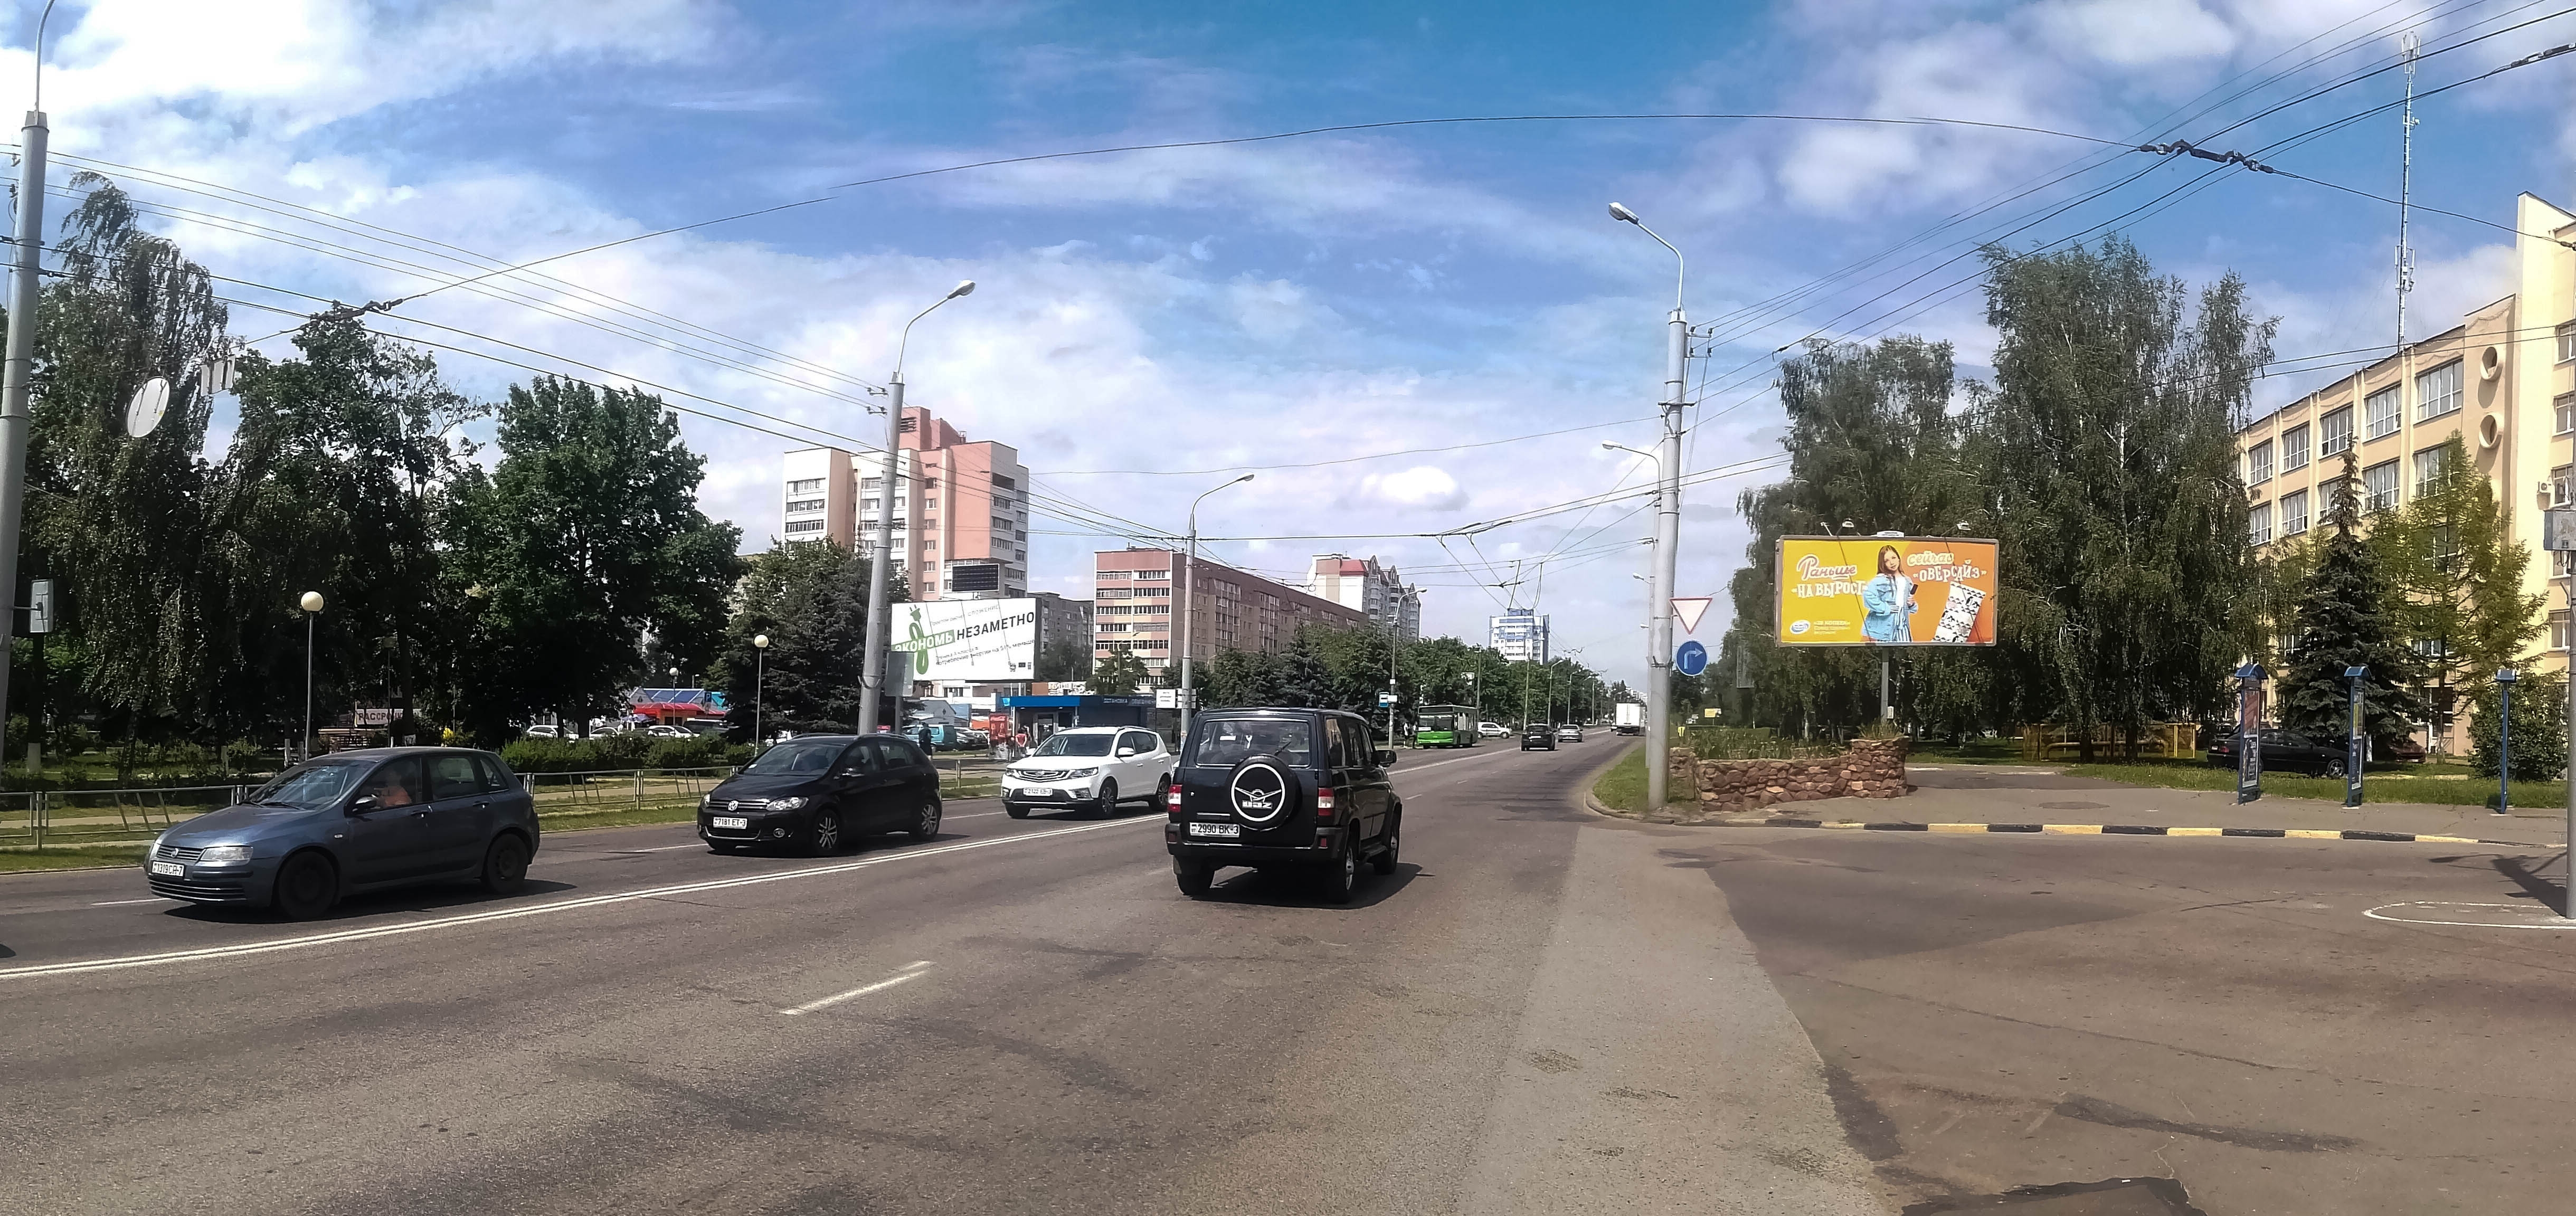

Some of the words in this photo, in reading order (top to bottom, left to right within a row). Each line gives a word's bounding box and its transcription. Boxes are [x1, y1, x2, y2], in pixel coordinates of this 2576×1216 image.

[1797, 554, 1857, 580] Раньше
[1907, 550, 1954, 566] сейчас
[1913, 559, 1987, 582] «ОВЕРСАЙЗ»
[956, 612, 1035, 640] НЕЗАМЕТНО
[1198, 823, 1216, 833] 2990
[1218, 824, 1238, 834] BK-3
